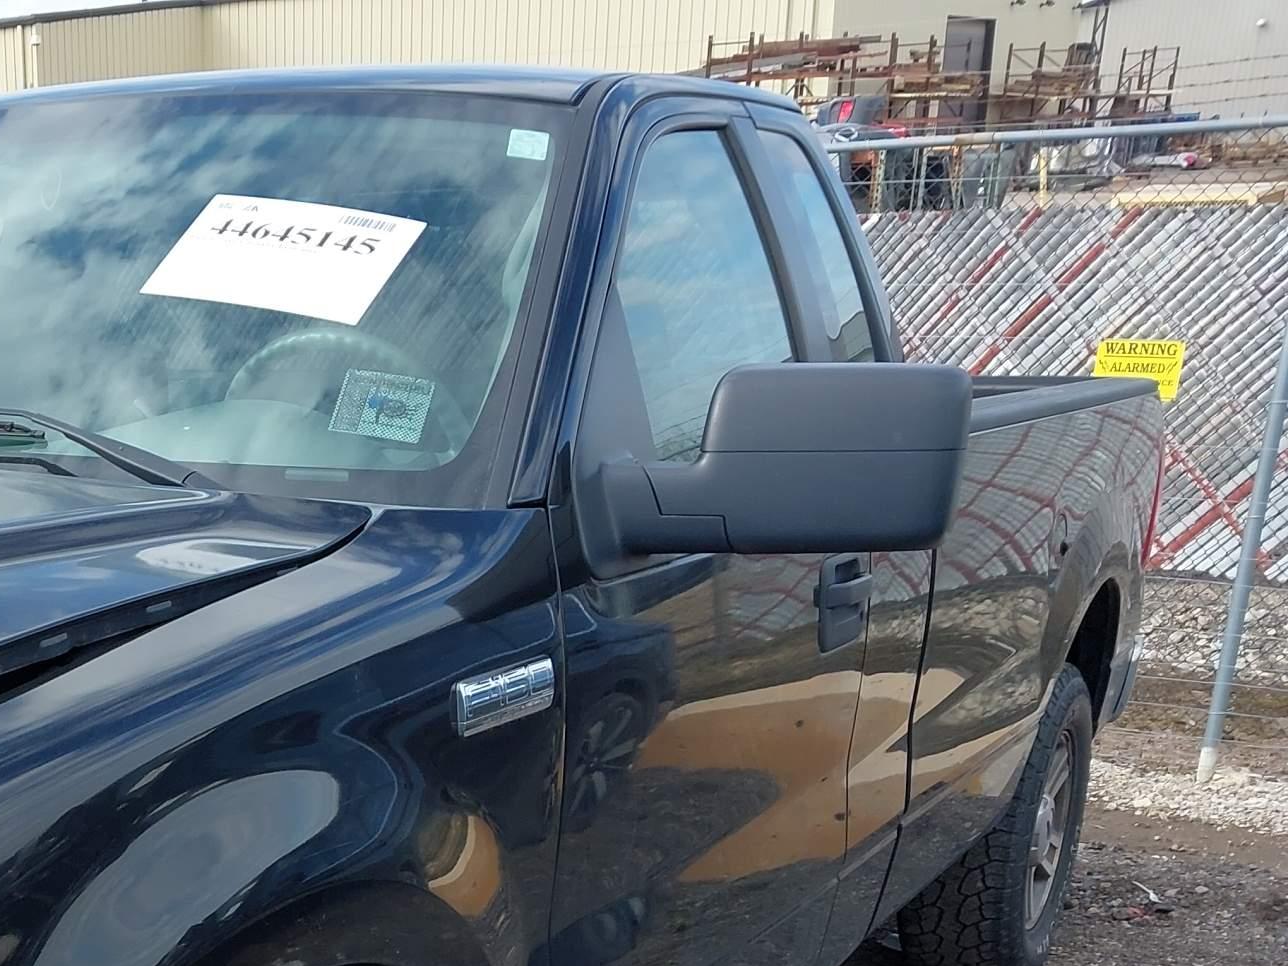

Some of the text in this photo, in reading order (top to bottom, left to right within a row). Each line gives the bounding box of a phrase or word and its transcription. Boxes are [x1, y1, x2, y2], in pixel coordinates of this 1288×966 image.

[210, 219, 381, 255] 44645145
[1105, 342, 1178, 356] WARNING
[1109, 361, 1166, 373] ALARMED
